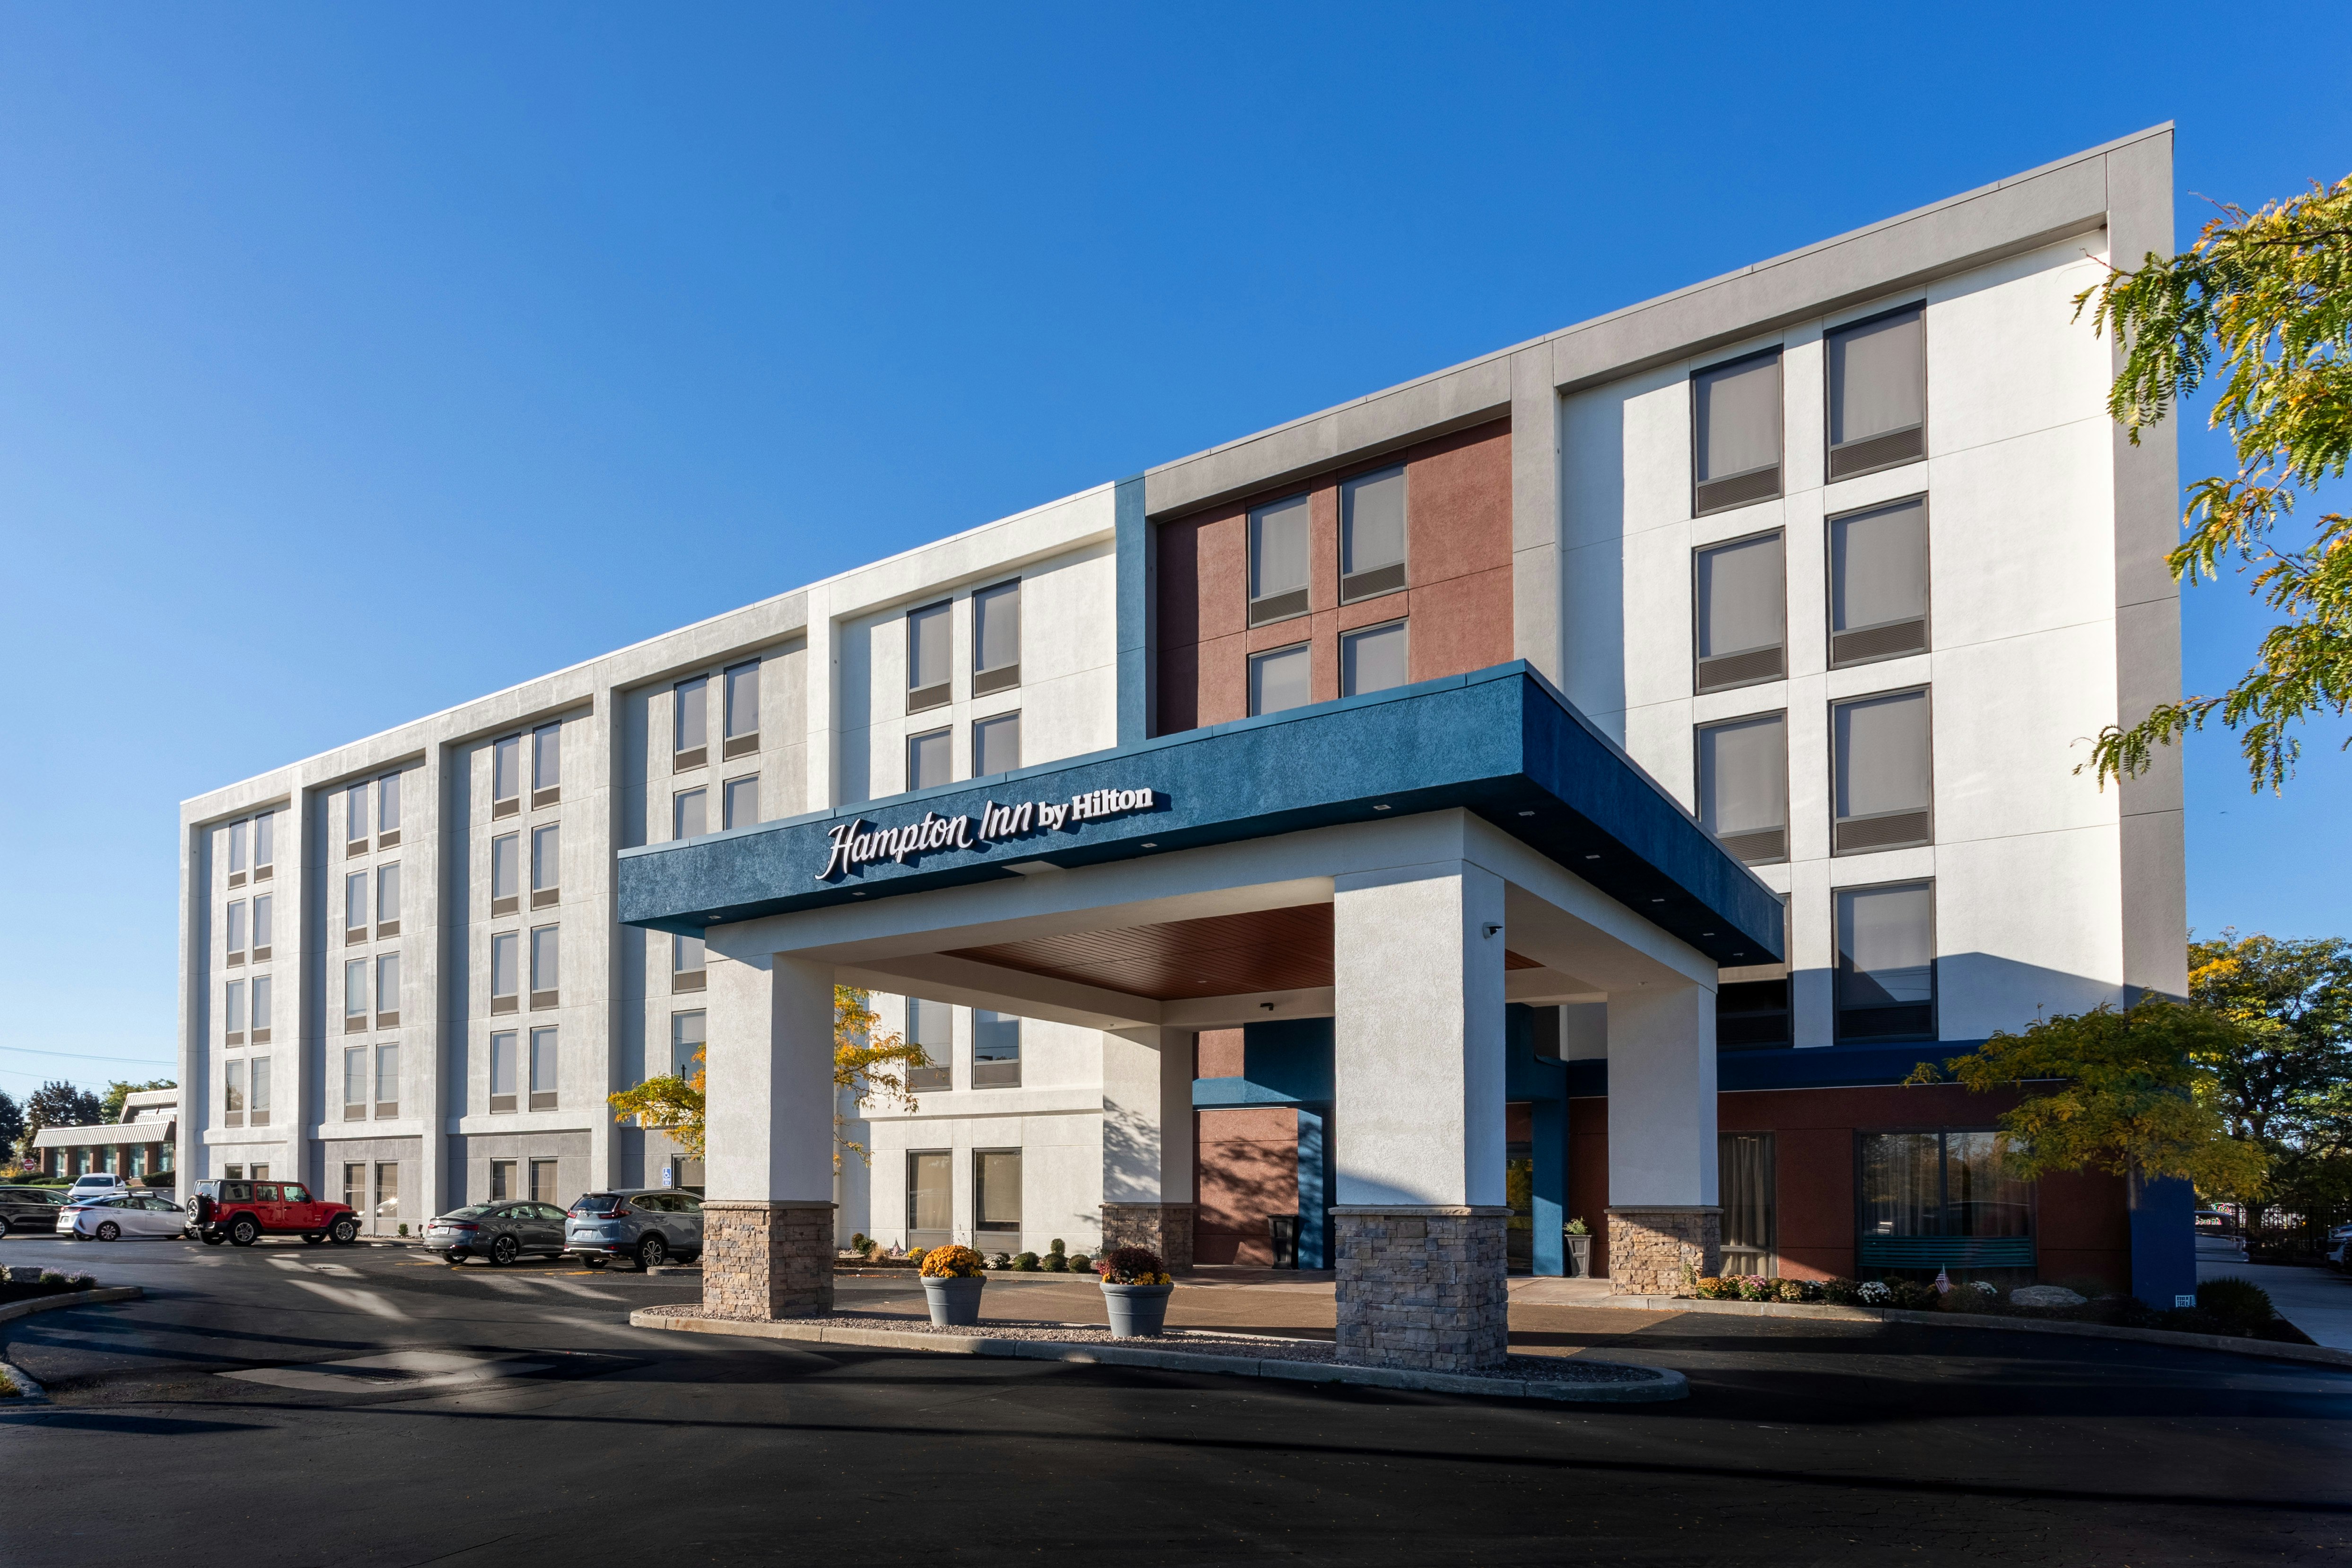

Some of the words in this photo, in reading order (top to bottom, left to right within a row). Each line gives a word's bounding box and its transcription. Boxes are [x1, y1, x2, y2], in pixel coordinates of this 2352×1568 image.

[814, 811, 973, 880] Hampton
[978, 800, 1032, 840] Inn
[1038, 801, 1069, 830] by
[1072, 788, 1154, 820] Hilton
